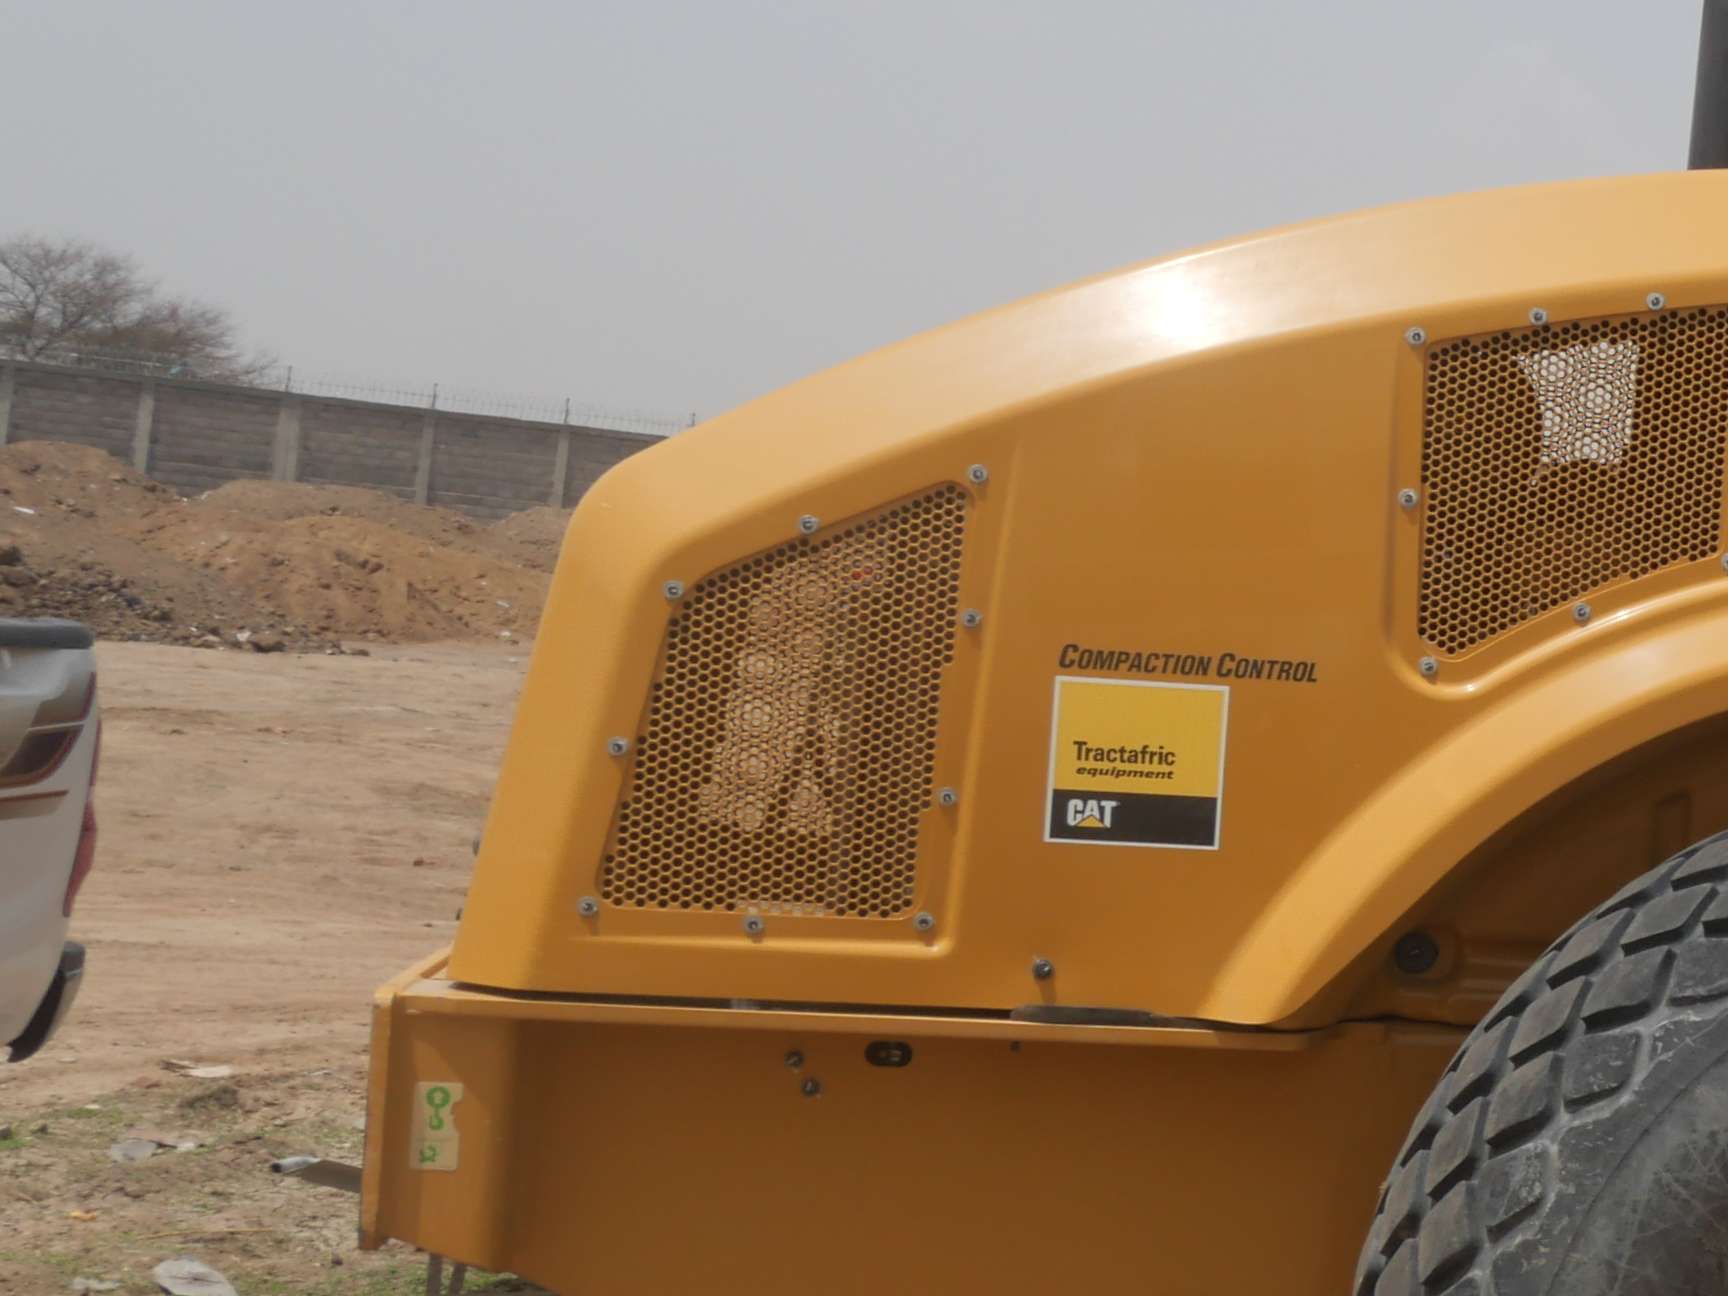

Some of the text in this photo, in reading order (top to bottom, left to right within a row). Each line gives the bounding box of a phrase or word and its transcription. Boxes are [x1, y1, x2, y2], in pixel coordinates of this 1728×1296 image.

[1059, 644, 1318, 683] COMPACTION CONTROL
[1073, 741, 1176, 767] Tractafric
[1075, 765, 1174, 780] equipment
[1066, 799, 1117, 829] CAT
